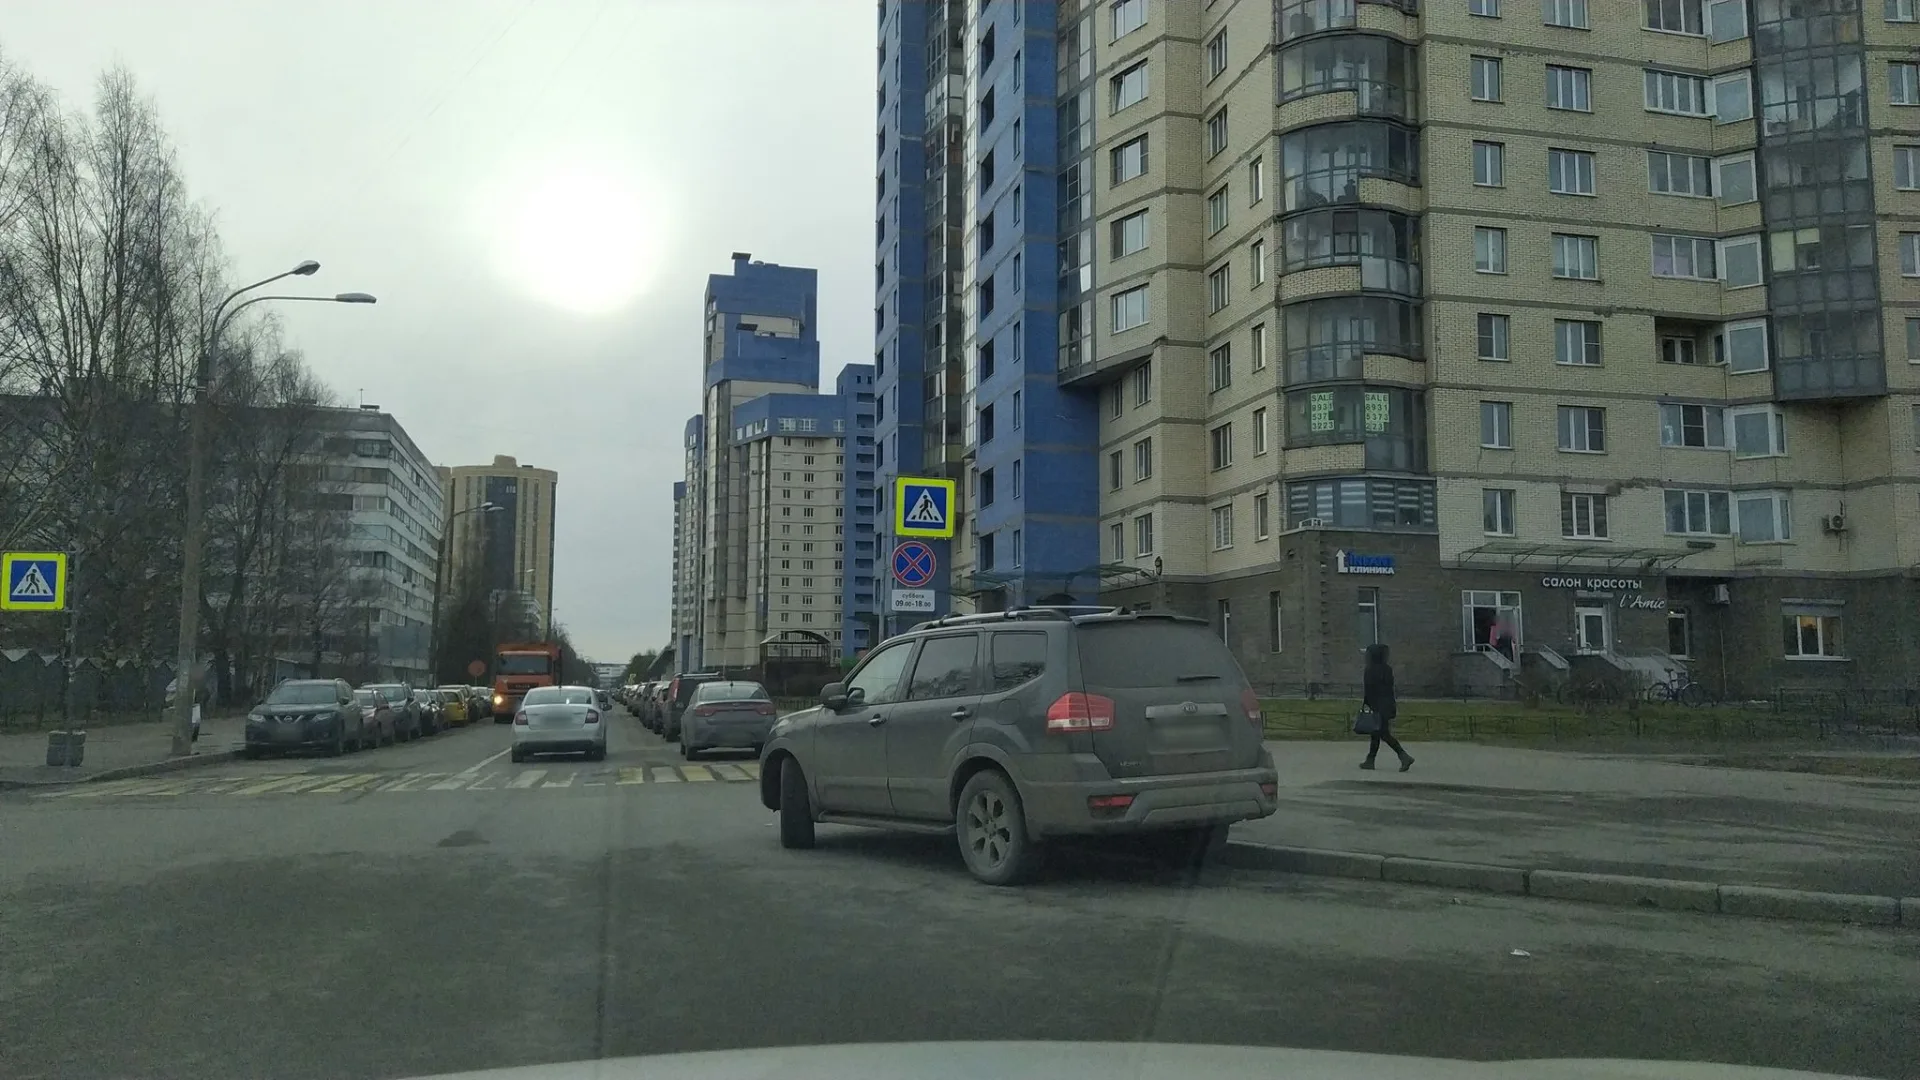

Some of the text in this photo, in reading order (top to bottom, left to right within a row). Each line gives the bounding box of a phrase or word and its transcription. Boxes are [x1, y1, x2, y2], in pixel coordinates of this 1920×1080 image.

[1365, 403, 1388, 411] 8931
[1312, 412, 1328, 421] 537
[1366, 413, 1389, 421] 5373
[1312, 421, 1334, 430] 3223
[1350, 566, 1394, 574] КЛИНИКА
[1542, 577, 1642, 590] салон красоты
